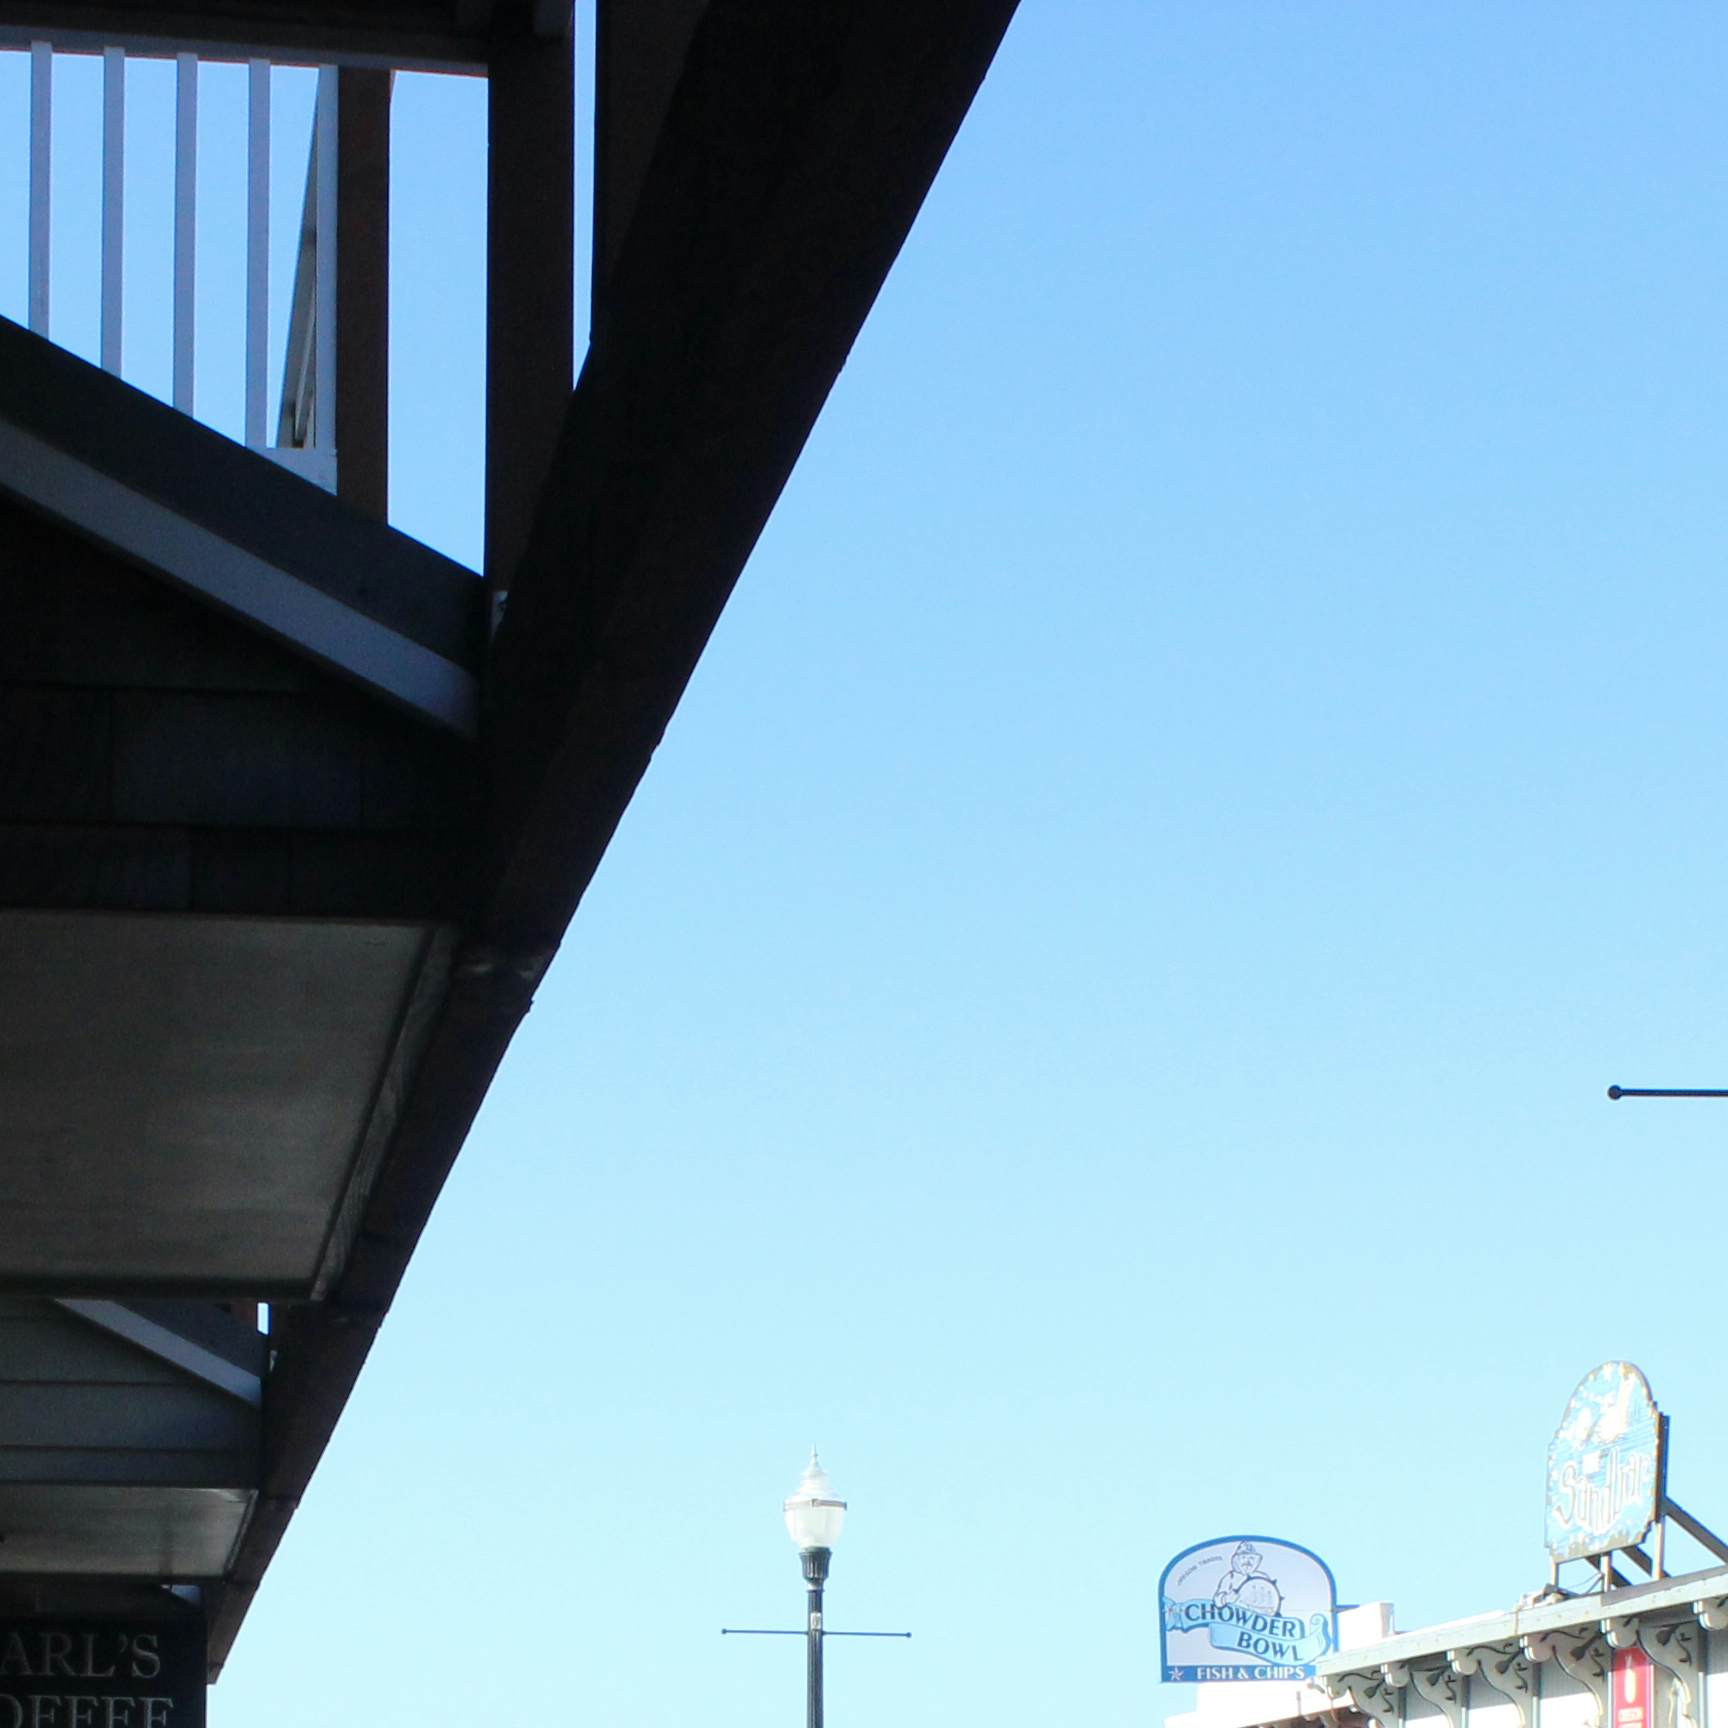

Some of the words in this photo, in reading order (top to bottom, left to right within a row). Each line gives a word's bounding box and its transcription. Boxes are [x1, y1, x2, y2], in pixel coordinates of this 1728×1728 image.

[1185, 1603, 1296, 1637] CHOWDER
[1237, 1631, 1304, 1662] BOWL
[1196, 1667, 1233, 1680] FISH
[1237, 1668, 1248, 1679] &
[1254, 1666, 1305, 1680] CHIPS
